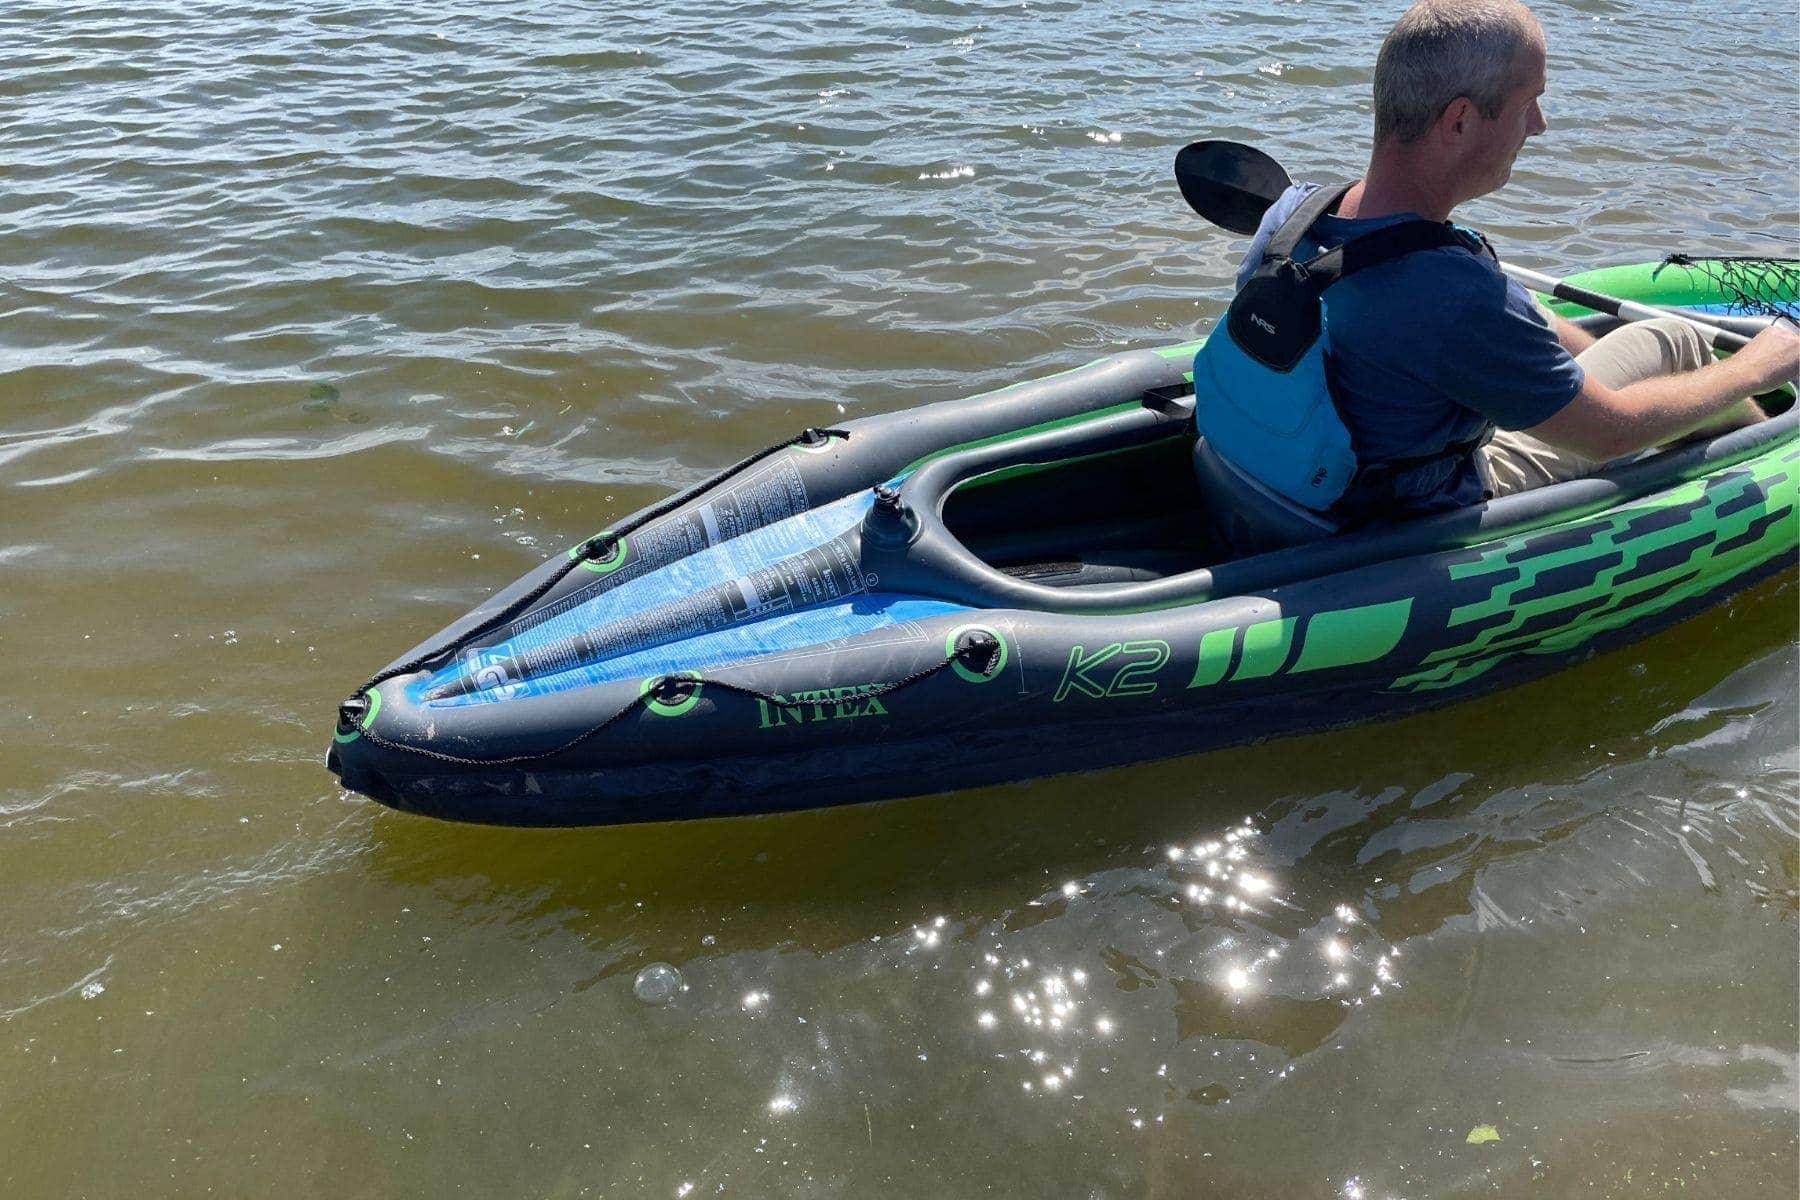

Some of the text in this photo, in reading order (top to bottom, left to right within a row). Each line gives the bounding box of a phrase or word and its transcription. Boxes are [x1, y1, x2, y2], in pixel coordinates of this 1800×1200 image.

[1251, 313, 1276, 335] NRS
[1053, 640, 1170, 702] K2
[755, 683, 888, 728] INTEX
